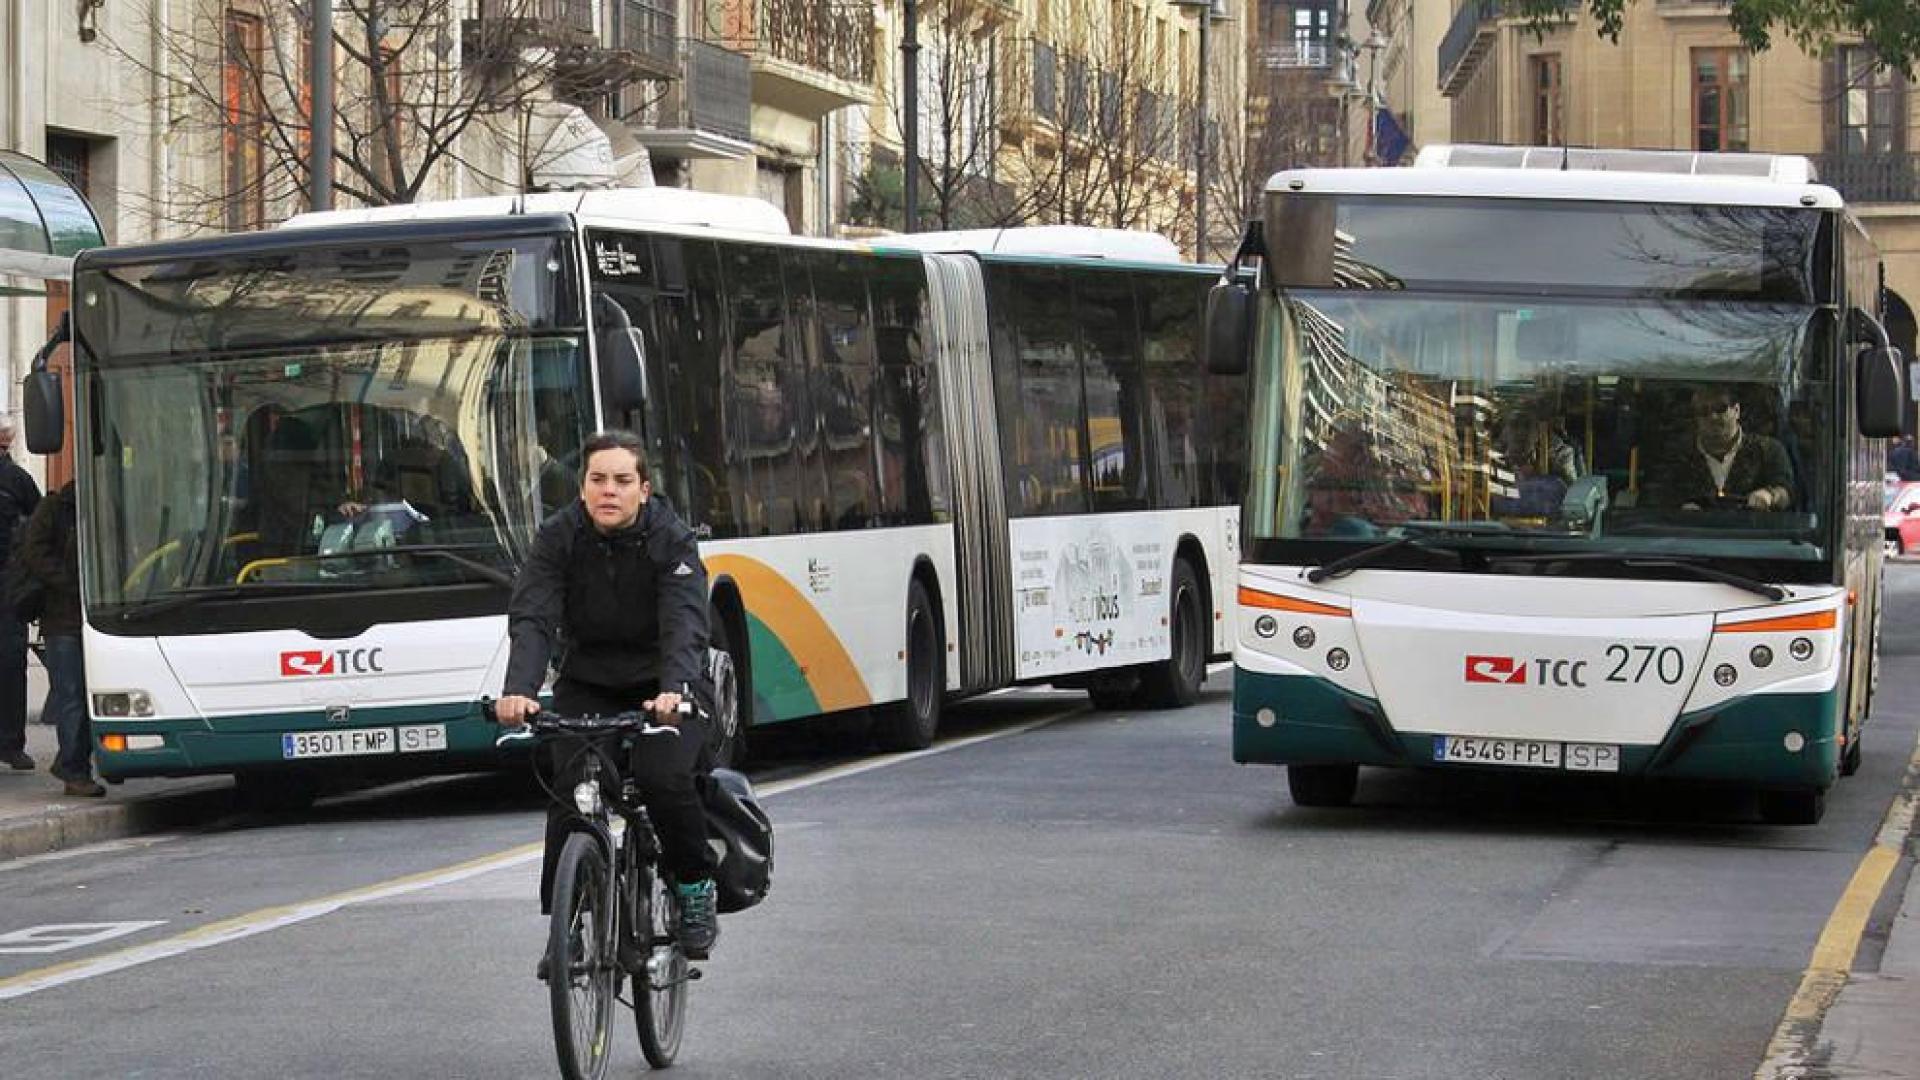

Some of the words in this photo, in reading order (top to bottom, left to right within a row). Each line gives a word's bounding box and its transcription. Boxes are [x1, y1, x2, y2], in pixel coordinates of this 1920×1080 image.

[336, 647, 383, 673] TCC
[1535, 658, 1588, 687] TCC
[1604, 643, 1685, 684] 270
[297, 733, 343, 755] 3501
[352, 731, 388, 749] FMP
[404, 728, 441, 749] SP
[1449, 740, 1506, 760] 4546
[1512, 743, 1554, 764] FPL
[1574, 746, 1611, 767] SP
